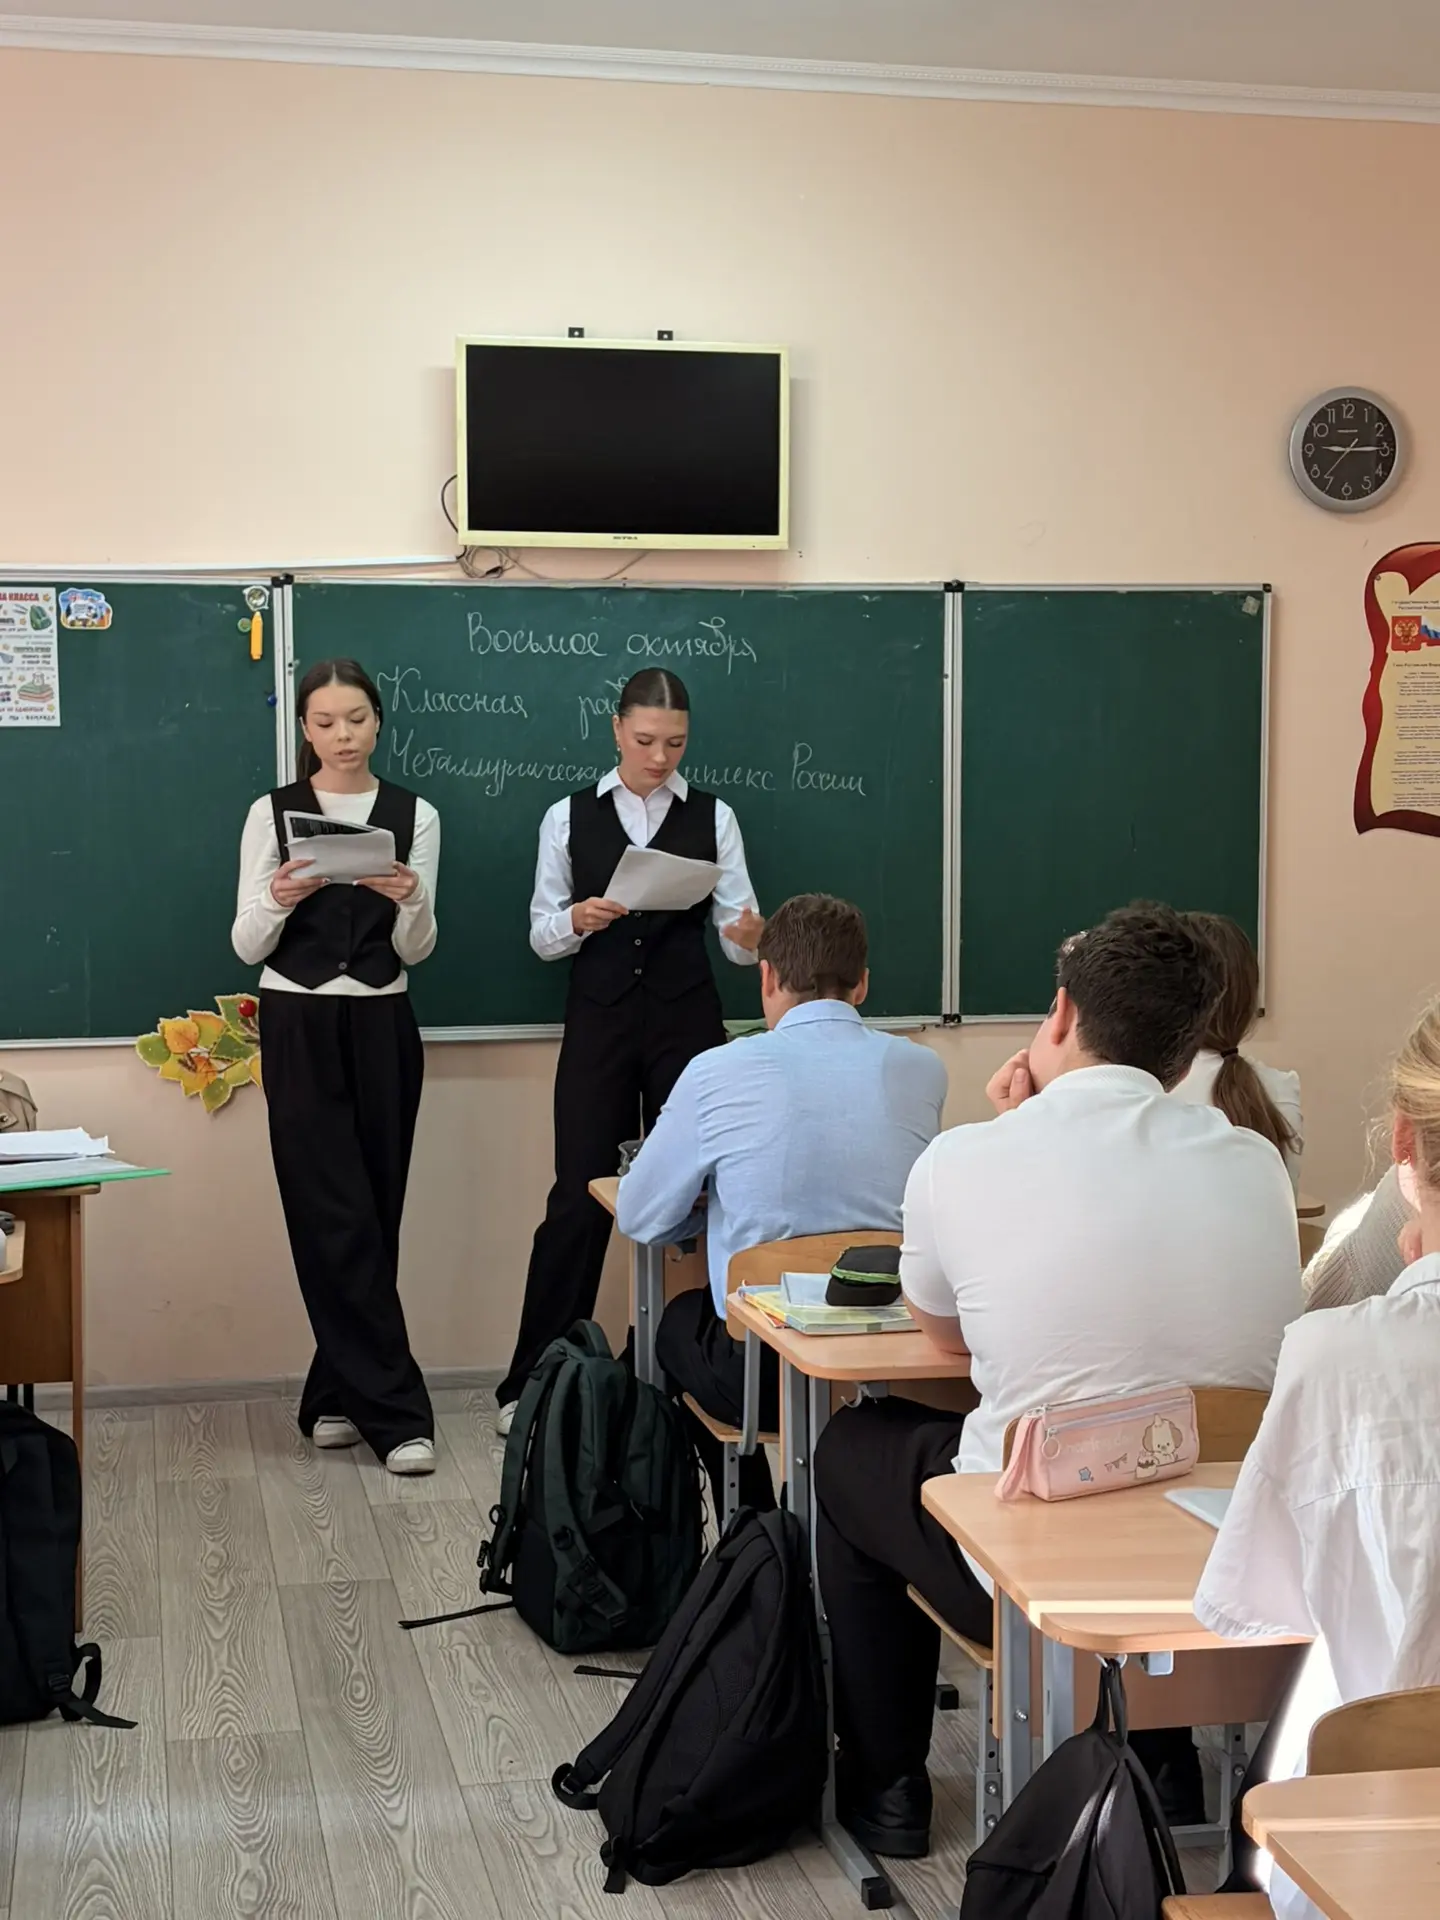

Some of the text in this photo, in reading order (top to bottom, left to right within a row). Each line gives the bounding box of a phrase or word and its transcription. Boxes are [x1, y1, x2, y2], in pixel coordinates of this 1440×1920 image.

[1327, 408, 1336, 424] 11
[1341, 403, 1355, 419] 12
[1363, 408, 1369, 423] 1
[1311, 422, 1329, 438] 10
[1374, 422, 1385, 437] 2
[1304, 443, 1315, 458] 9
[1379, 441, 1390, 457] 3
[1310, 463, 1321, 478] 8
[1374, 462, 1383, 477] 4
[1324, 475, 1334, 491] 7
[1341, 482, 1353, 496] 6
[1361, 475, 1372, 490] 5
[467, 611, 757, 675] Восьмое октября
[376, 666, 528, 719] Классная
[387, 726, 867, 797] Металлургически мплекс России
